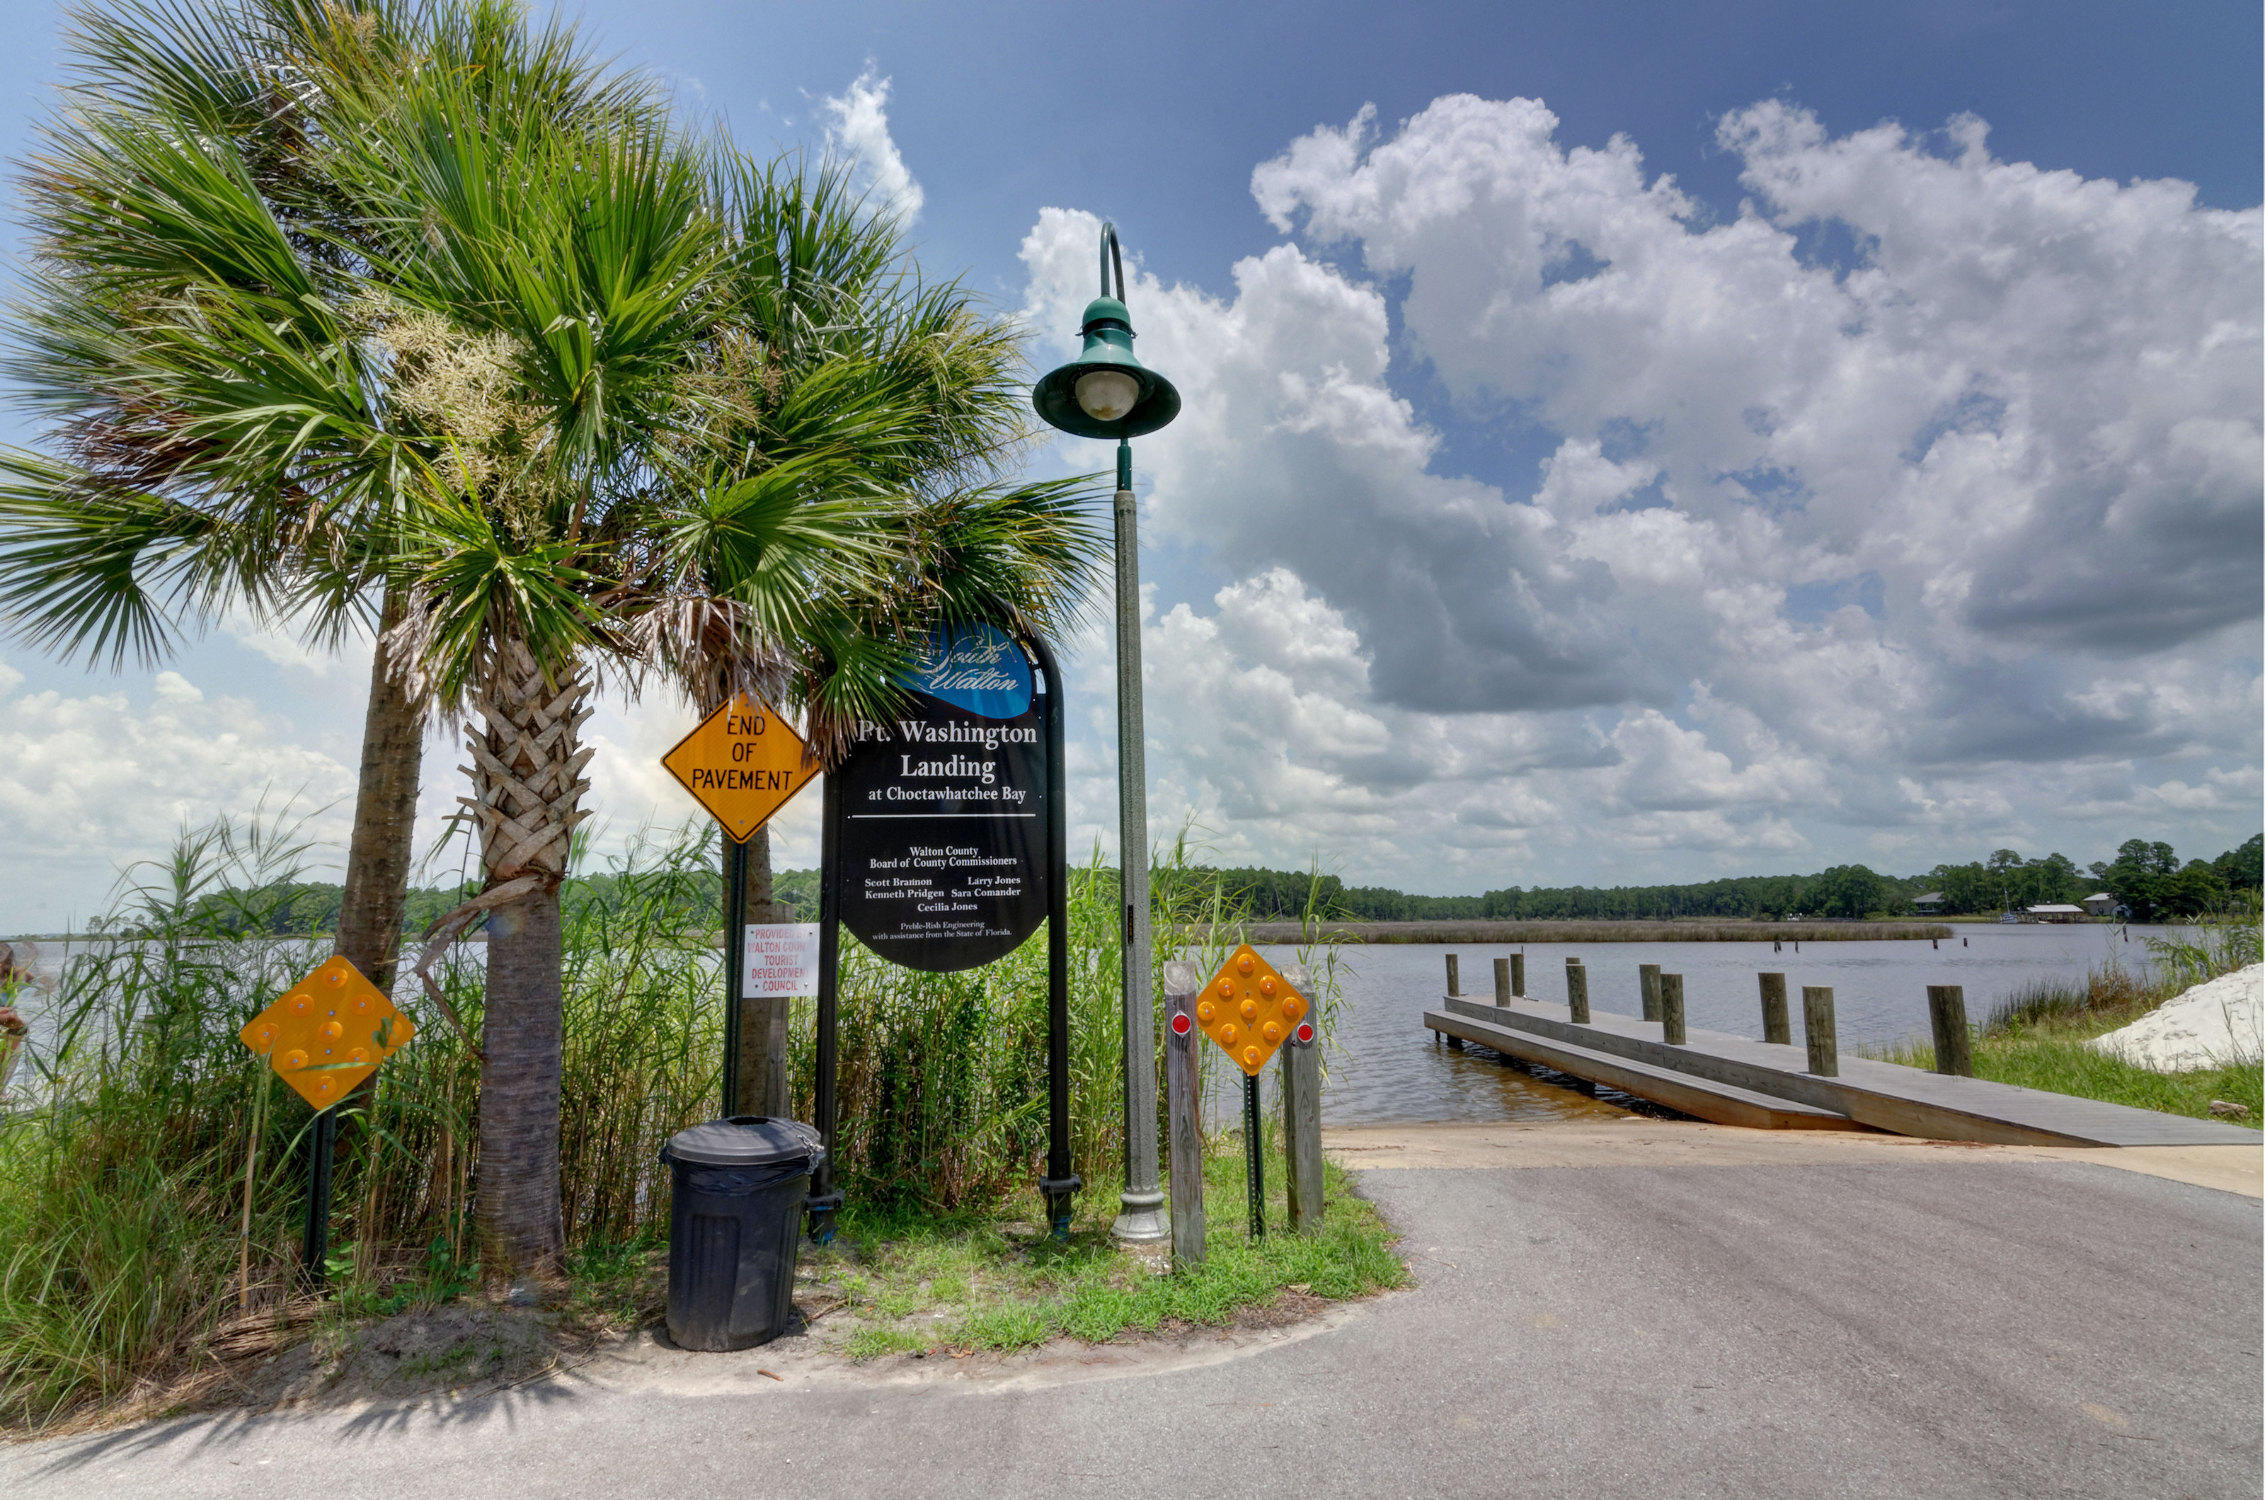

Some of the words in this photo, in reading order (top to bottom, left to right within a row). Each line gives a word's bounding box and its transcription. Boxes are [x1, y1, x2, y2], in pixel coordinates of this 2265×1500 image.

[929, 664, 1018, 691] Walton
[727, 715, 765, 735] END
[897, 720, 1038, 750] Washington
[732, 742, 757, 762] OF
[900, 754, 996, 784] Landing
[692, 768, 793, 790] PAVEMENT
[868, 788, 882, 801] at
[886, 786, 998, 801] Choctawhatchee
[1002, 786, 1026, 804] Bay
[909, 846, 944, 856] Walton
[945, 845, 979, 858] County
[870, 859, 898, 869] Board
[899, 858, 910, 868] of
[913, 858, 946, 870] County
[949, 856, 1018, 867] Commissioners
[864, 878, 890, 887] Scott
[893, 877, 932, 886] Brannon
[967, 876, 993, 888] Larry
[994, 876, 1021, 885] Jones
[865, 889, 905, 899] Kenneth
[907, 889, 945, 900] Pridgen
[951, 888, 972, 898] Sara
[974, 887, 1021, 897] Comander
[917, 902, 950, 912] Cecilia
[951, 902, 978, 912] Jones
[942, 921, 985, 931] Engineering
[872, 932, 889, 940] with
[889, 931, 924, 940] assistance
[925, 930, 943, 939] from
[943, 930, 955, 938] the
[956, 929, 974, 938] State
[974, 929, 985, 937] of
[764, 954, 799, 966] TOURIST
[763, 980, 798, 992] COUNCIL
